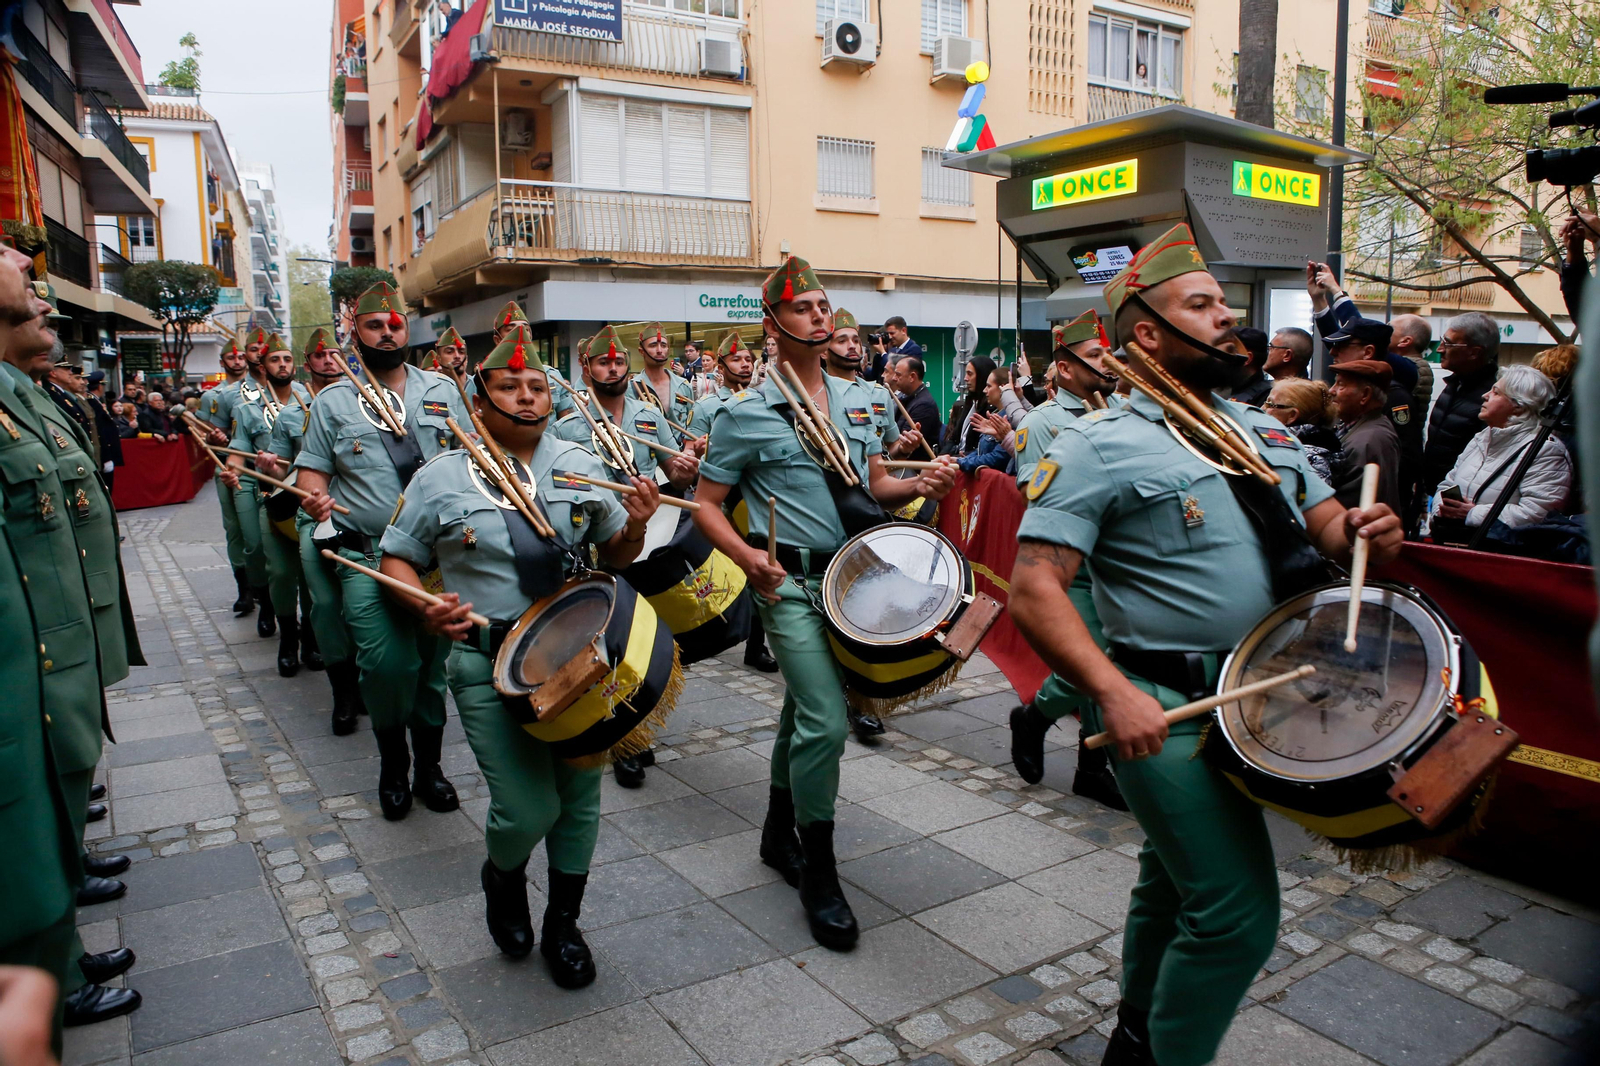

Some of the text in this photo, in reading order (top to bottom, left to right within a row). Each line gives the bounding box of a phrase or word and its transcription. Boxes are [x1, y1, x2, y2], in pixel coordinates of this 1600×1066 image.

[532, 3, 538, 11] y
[580, 8, 616, 21] Aplicada
[502, 16, 616, 40] MARÍA JOSÉ SEGOVIA
[1061, 166, 1128, 198] ONCE
[1259, 171, 1312, 200] ONCE
[699, 293, 763, 308] Carrefour
[727, 309, 763, 320] express
